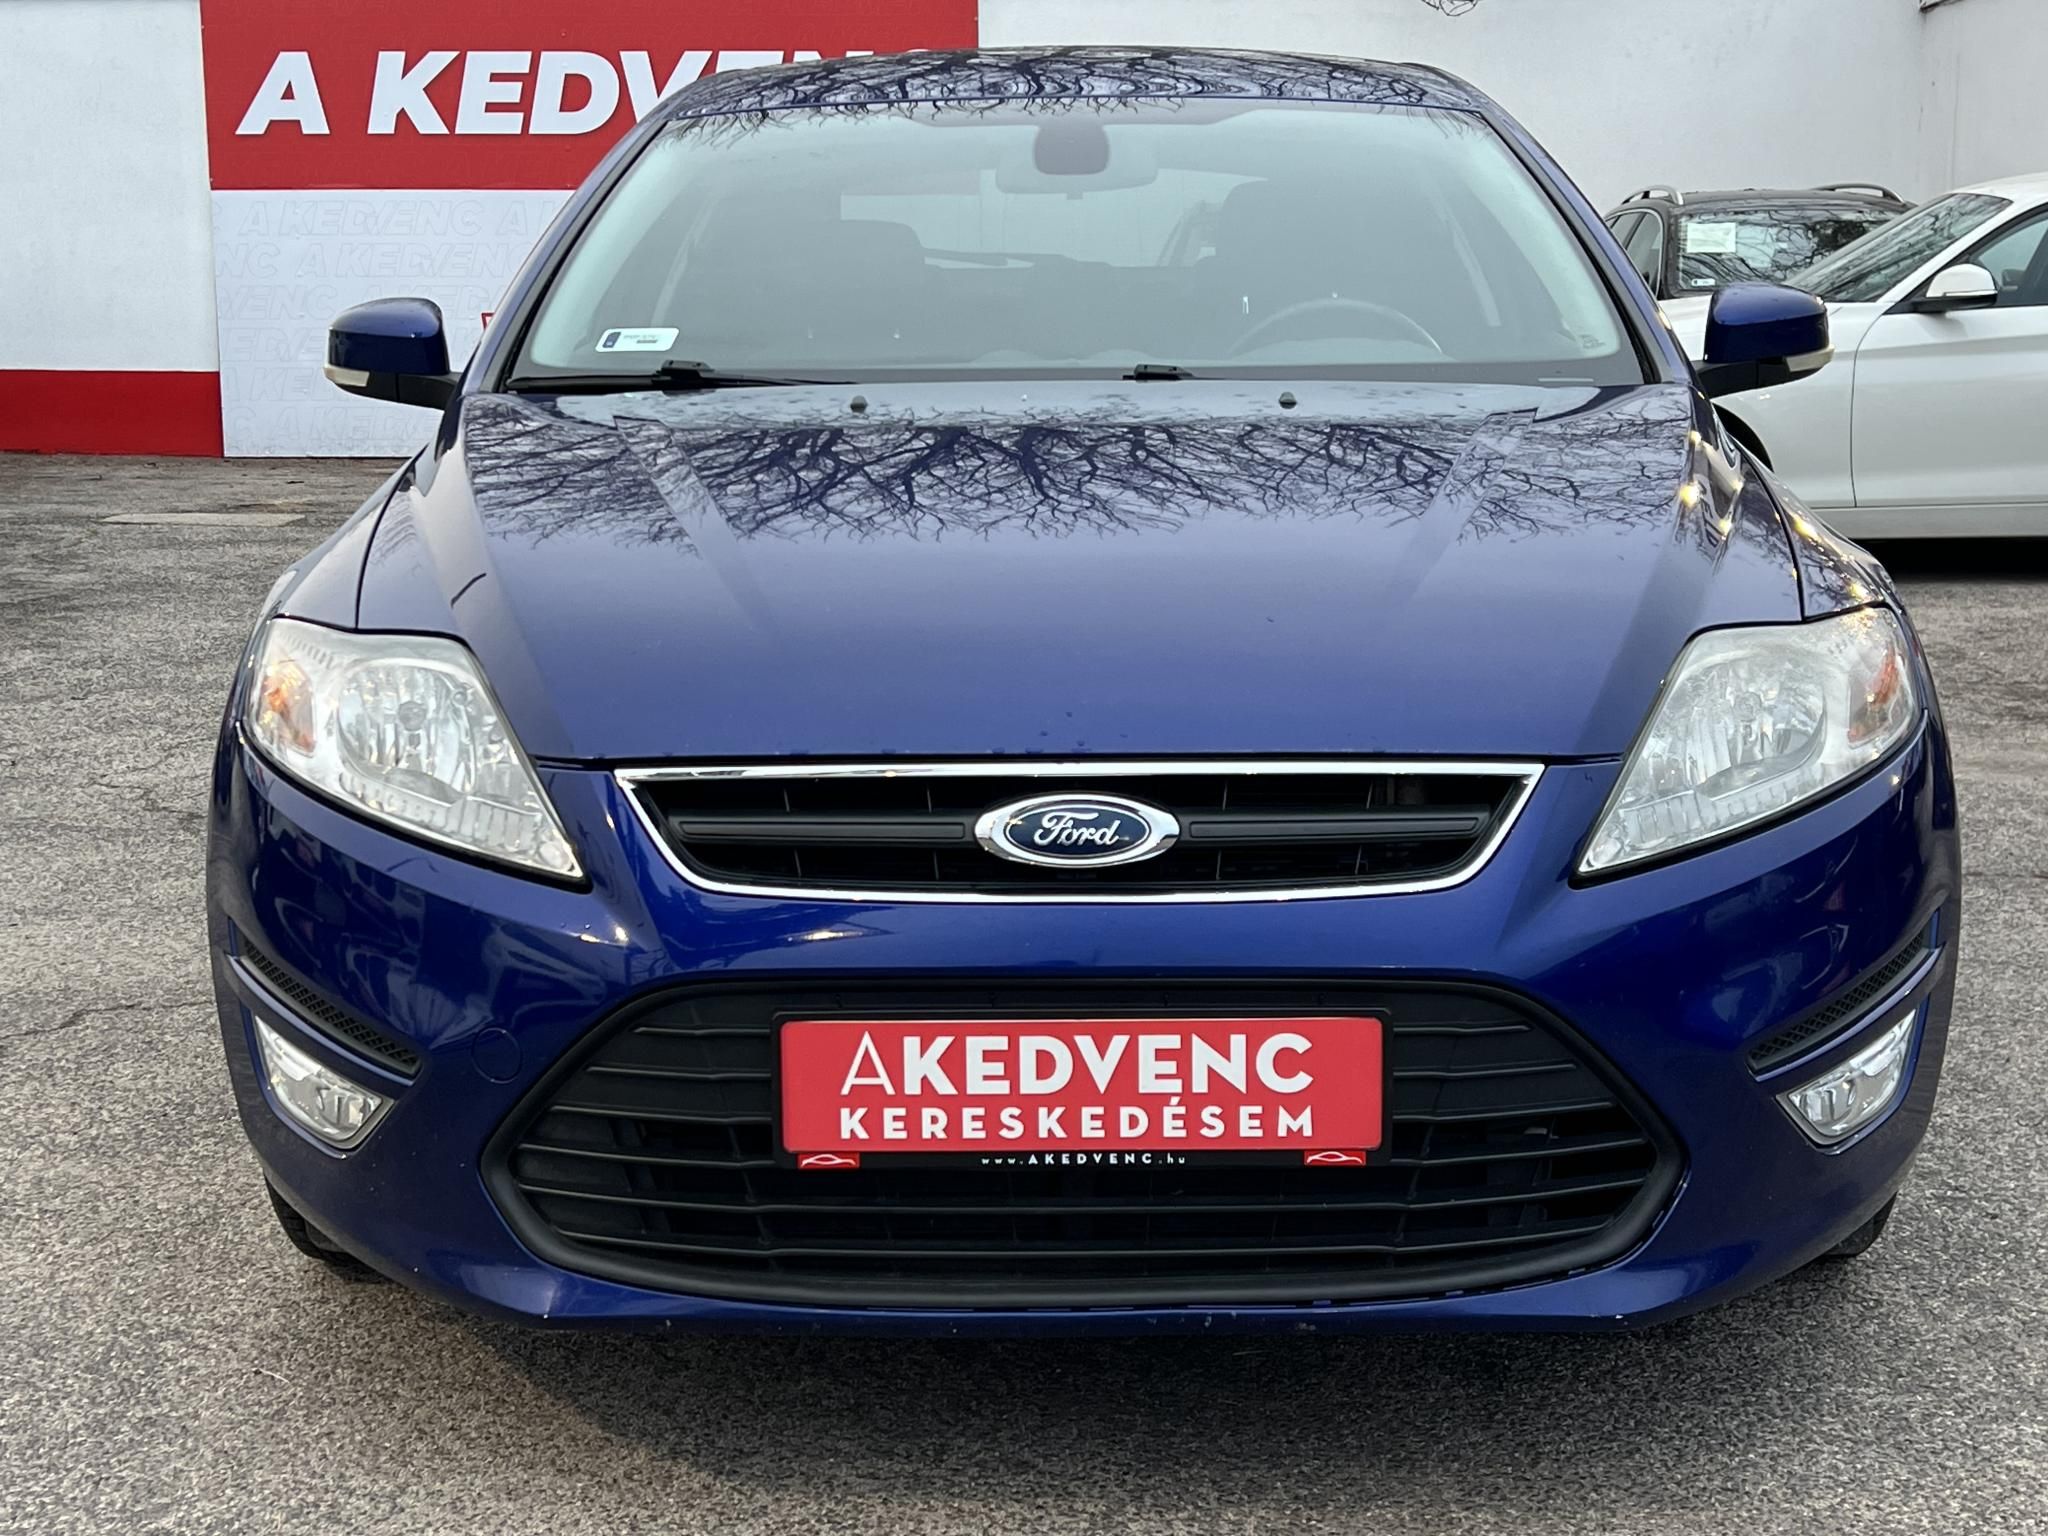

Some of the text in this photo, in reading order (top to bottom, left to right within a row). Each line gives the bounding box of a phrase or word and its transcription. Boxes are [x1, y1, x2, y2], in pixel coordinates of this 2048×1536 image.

[235, 49, 929, 135] A KEDV
[1033, 811, 1122, 846] Ford
[840, 1096, 1313, 1140] KERESKEDÉSEM
[981, 1153, 1185, 1165] www.AKEDVENC.hu
